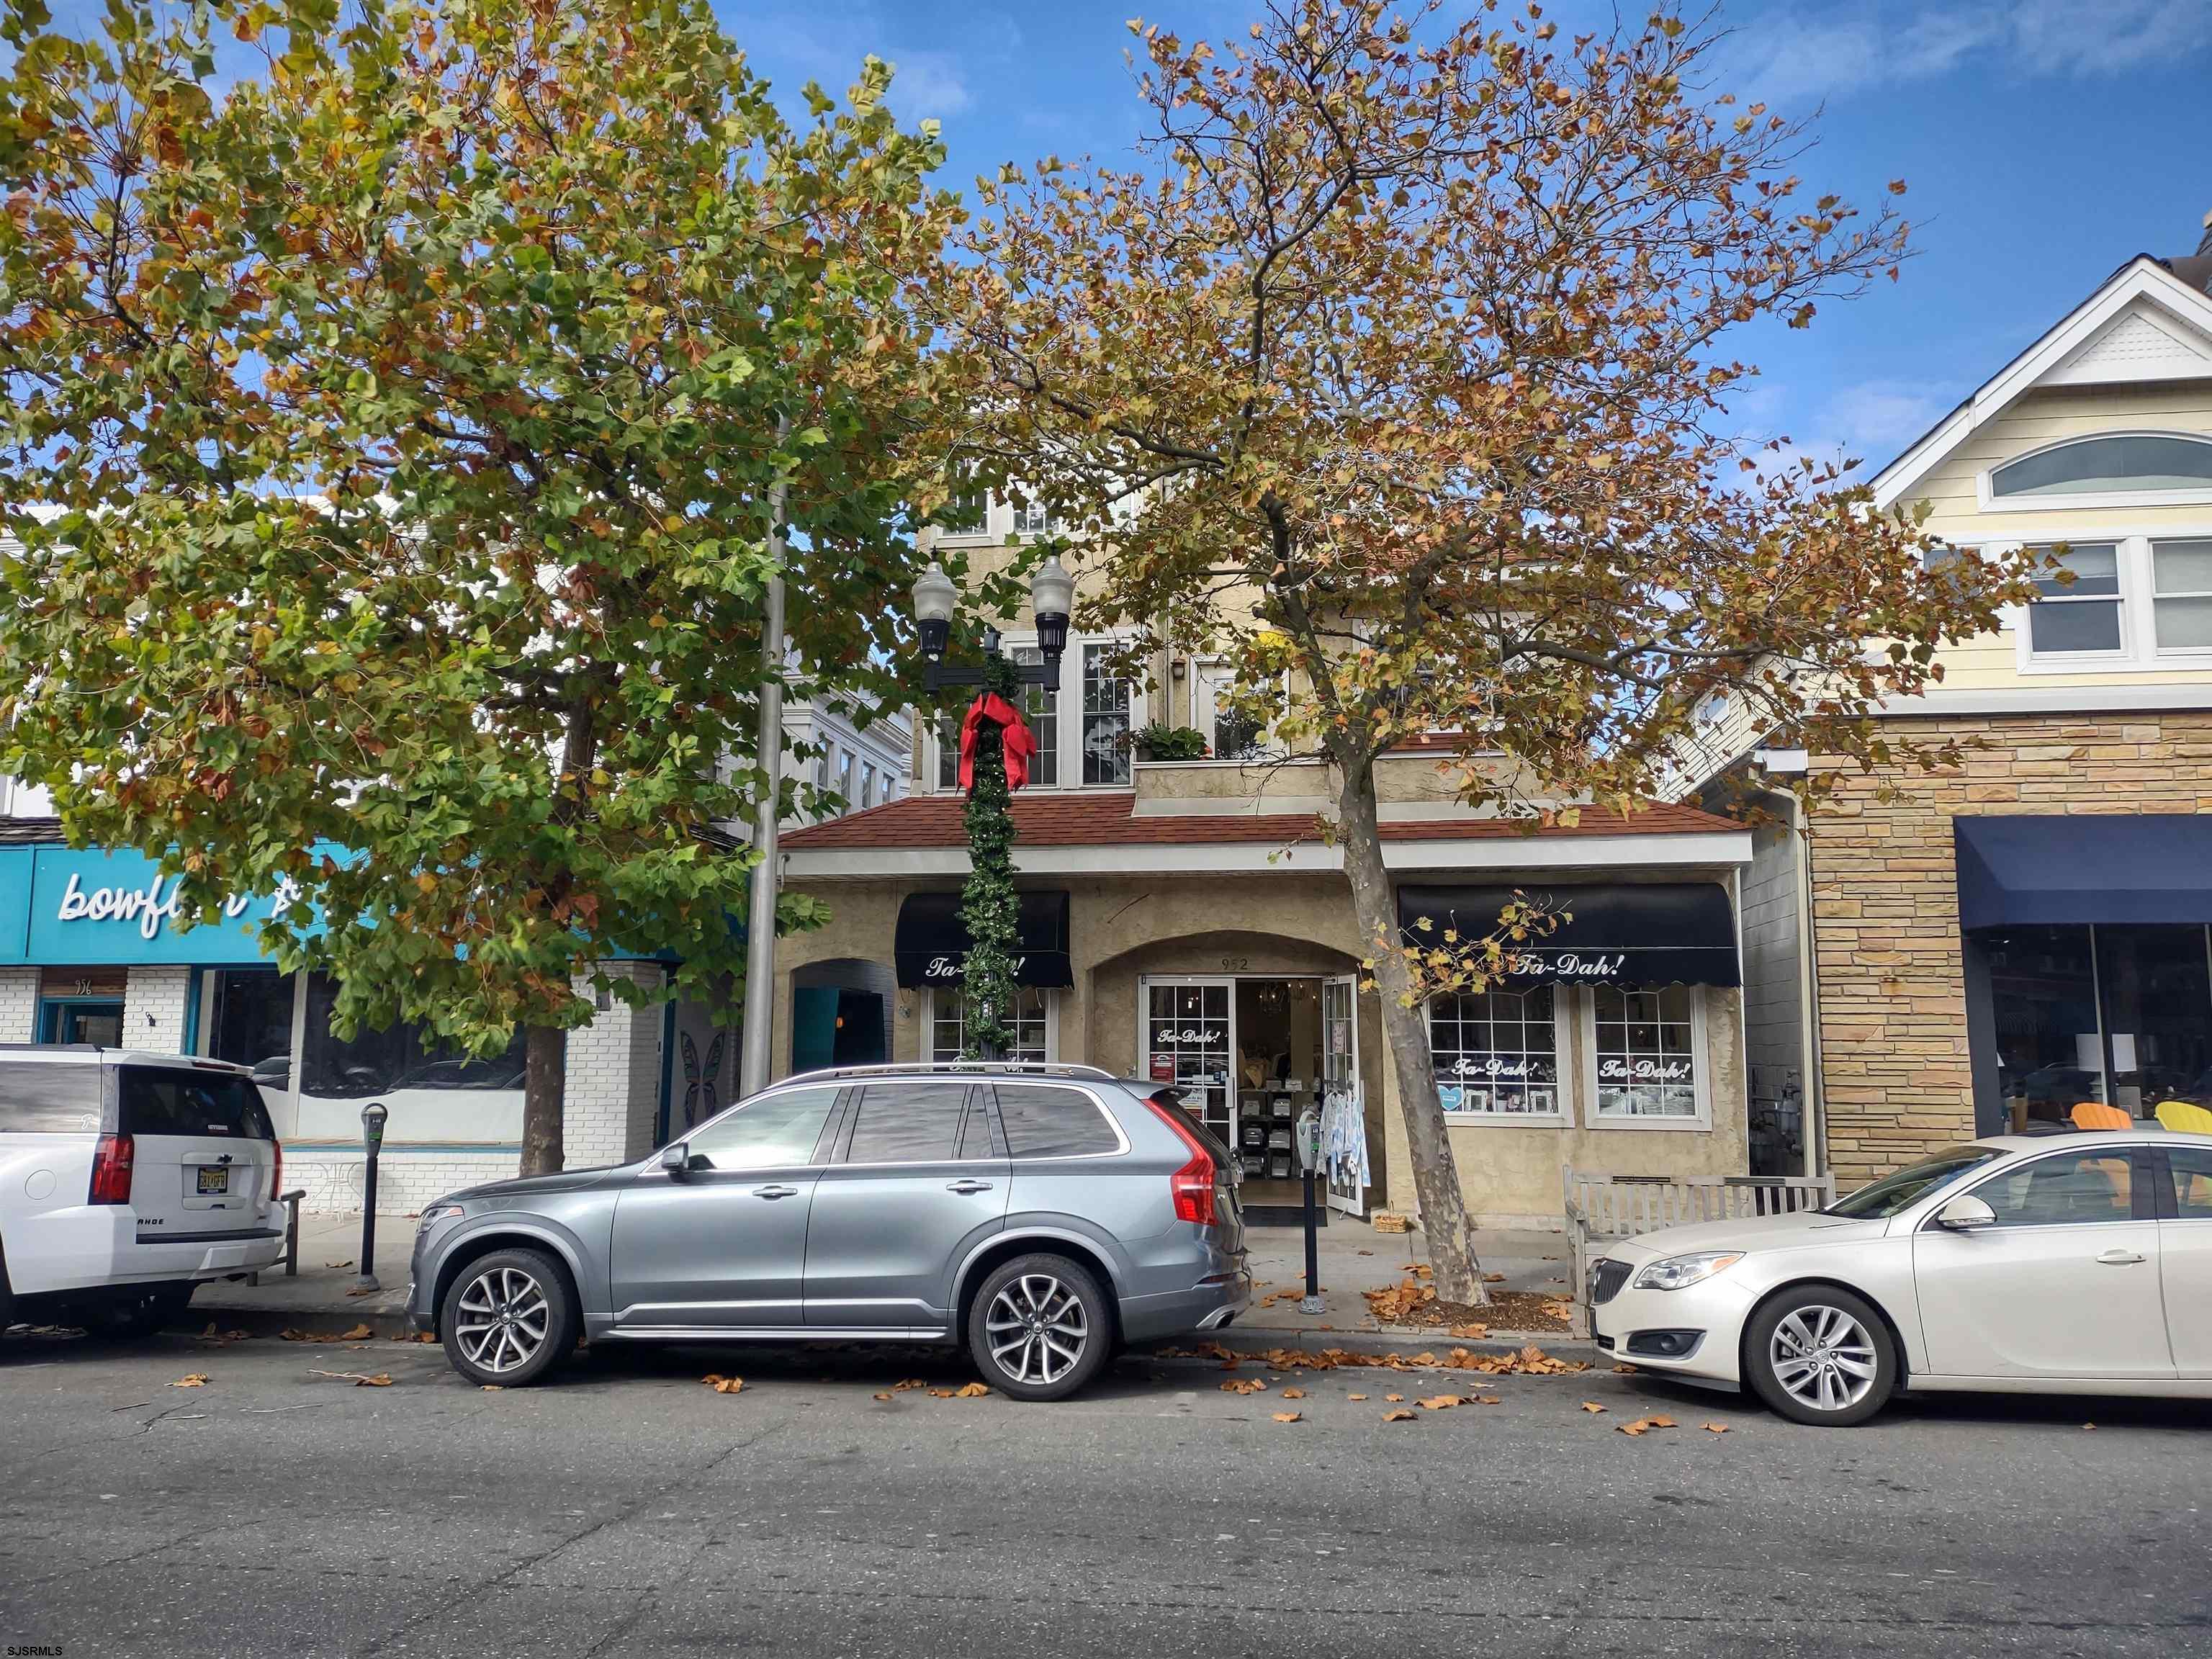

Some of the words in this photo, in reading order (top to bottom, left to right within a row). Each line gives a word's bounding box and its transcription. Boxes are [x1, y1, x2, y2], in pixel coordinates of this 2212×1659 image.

[1513, 953, 1625, 975] Ta-Dah!
[75, 979, 91, 995] 956
[1156, 1029, 1220, 1043] Ta-Dah!
[1599, 1059, 1691, 1079] Ta-Dah!
